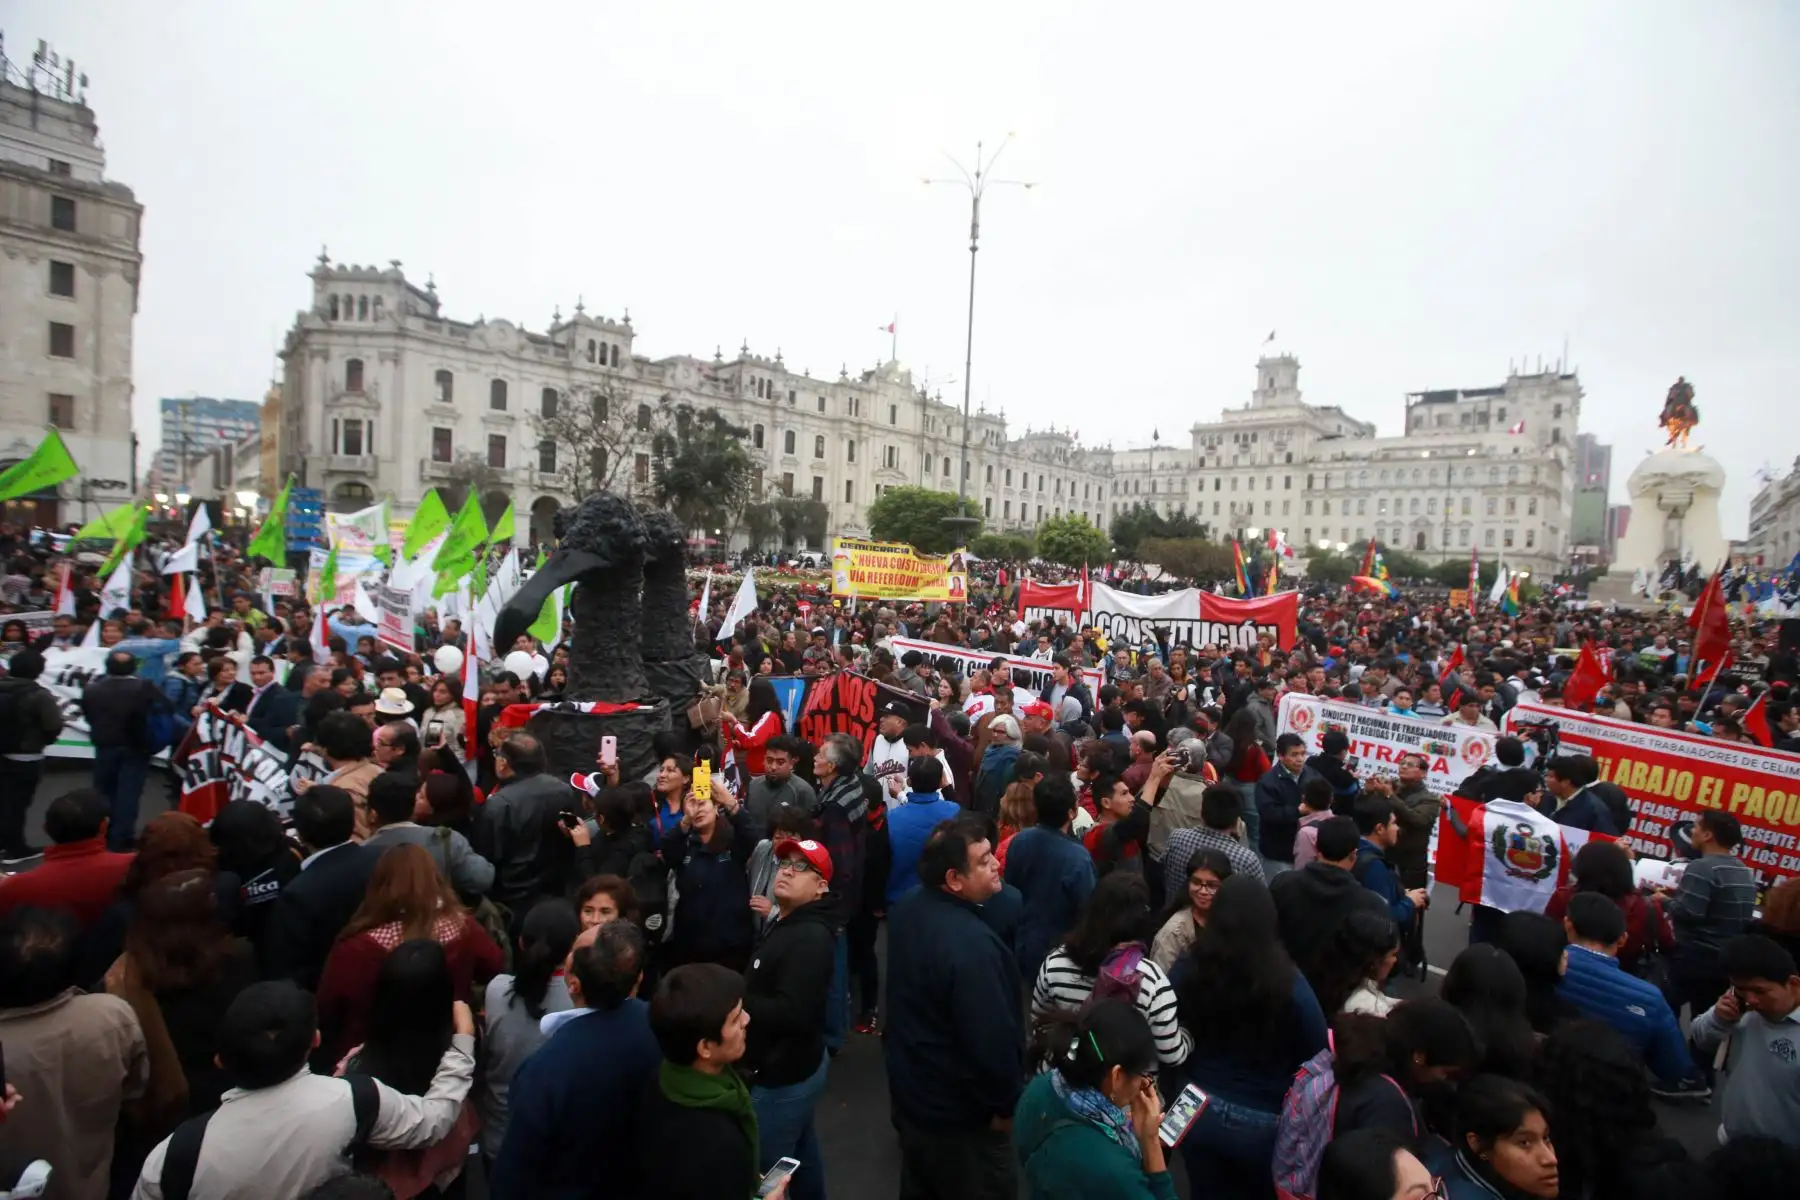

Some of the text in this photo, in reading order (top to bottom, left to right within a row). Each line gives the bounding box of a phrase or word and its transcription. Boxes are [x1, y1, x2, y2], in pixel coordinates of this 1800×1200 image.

[1321, 708, 1457, 743] SINDICATO NACIONAL DE TRABAJADORES
[1350, 724, 1421, 746] DE BEBIDAS Y AFINES
[1579, 723, 1628, 741] UNITARIO
[1630, 735, 1646, 745] DE
[1647, 738, 1738, 764] TRABAJADORES
[1741, 757, 1758, 768] DE
[1613, 757, 1695, 802] ABAJO
[1696, 775, 1724, 809] EL
[1641, 801, 1681, 821] CLASE
[1637, 819, 1662, 837] LOS
[1742, 844, 1753, 859] Y
[1751, 847, 1779, 866] LOS
